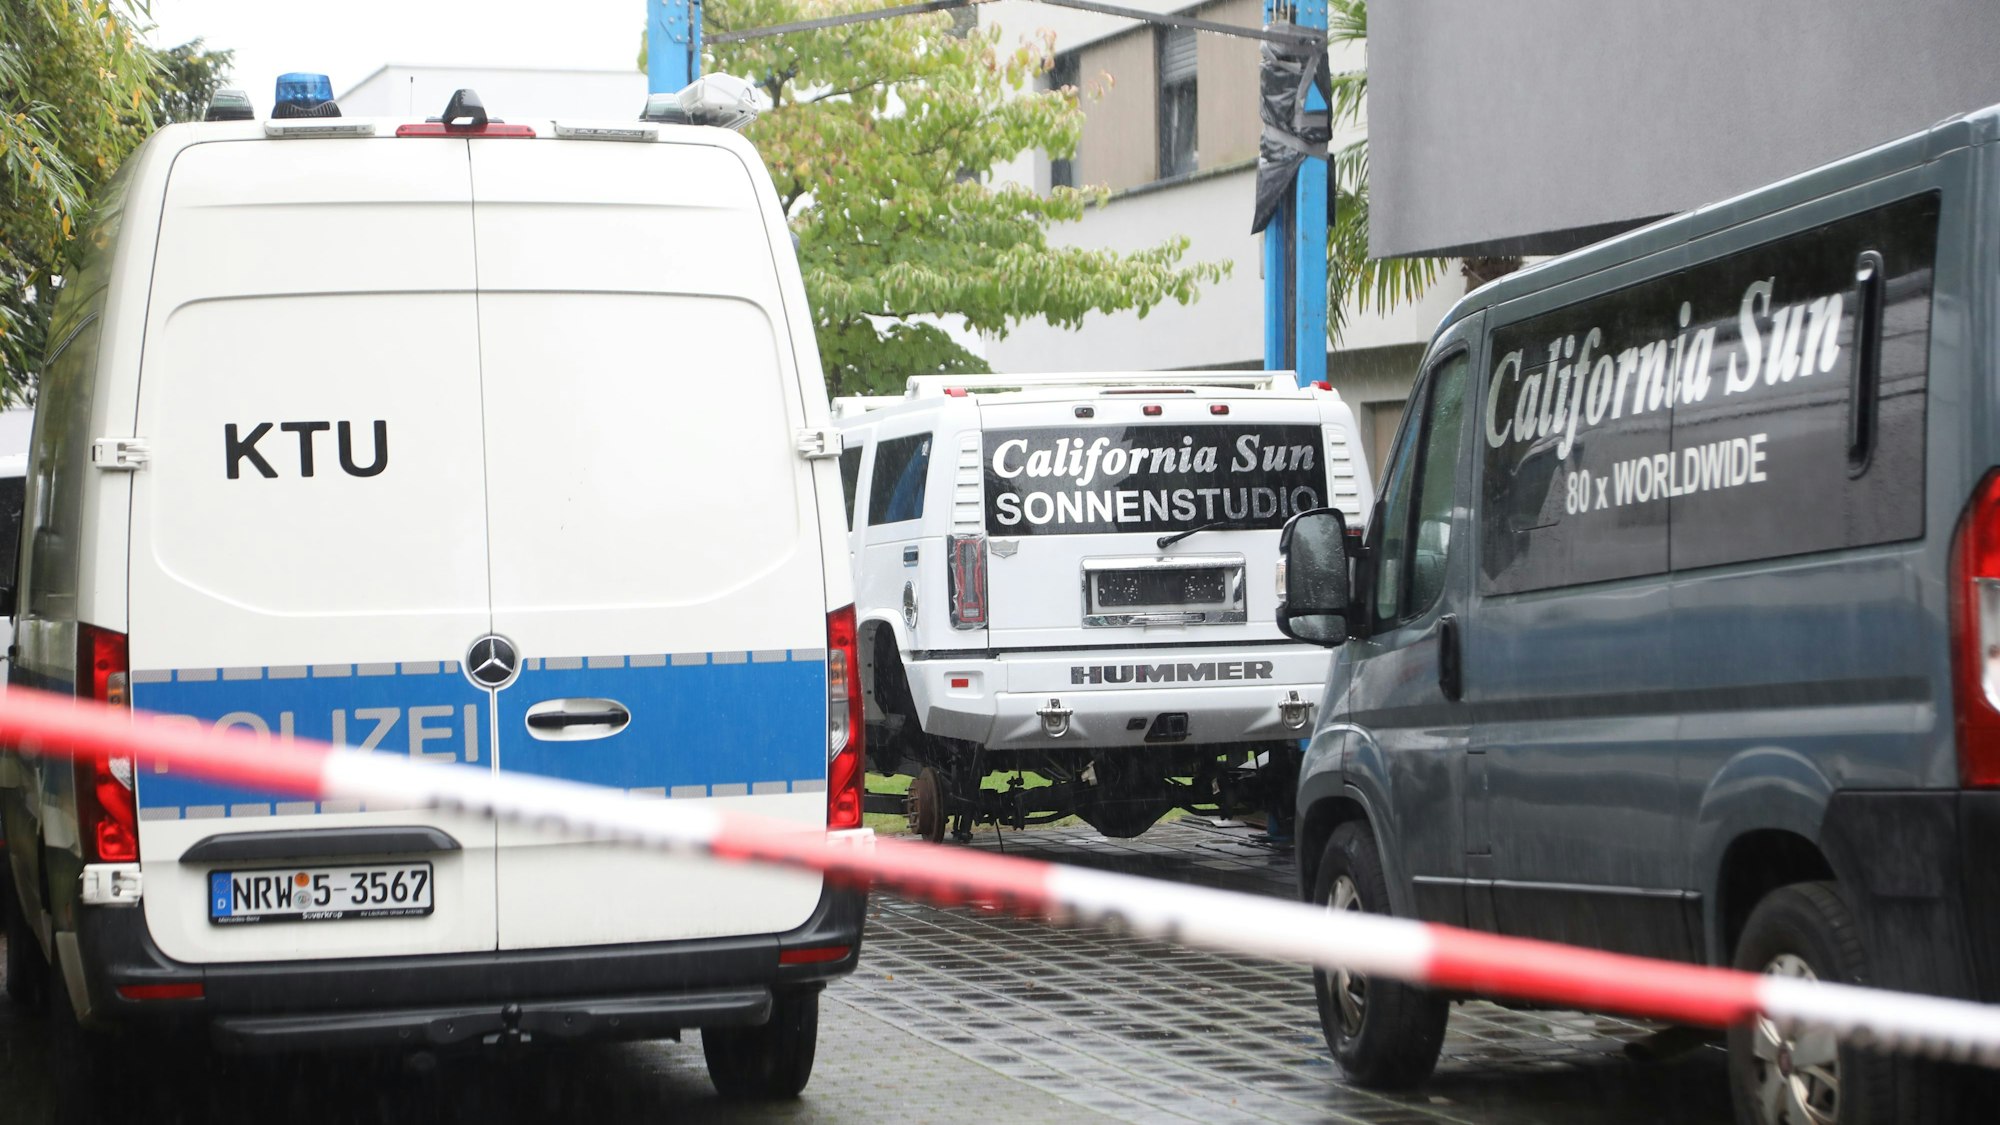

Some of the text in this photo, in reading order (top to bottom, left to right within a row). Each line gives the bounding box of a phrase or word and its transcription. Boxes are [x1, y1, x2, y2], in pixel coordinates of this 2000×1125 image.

[1486, 276, 1844, 460] California Sun
[225, 420, 388, 480] KTU
[992, 435, 1315, 486] California Sun
[1566, 433, 1767, 515] 80 x WORLDWIDE
[996, 485, 1319, 526] SONNENSTUDIO
[1071, 660, 1274, 685] HUMMER
[217, 898, 226, 910] D
[233, 870, 428, 910] NRW 5-3567
